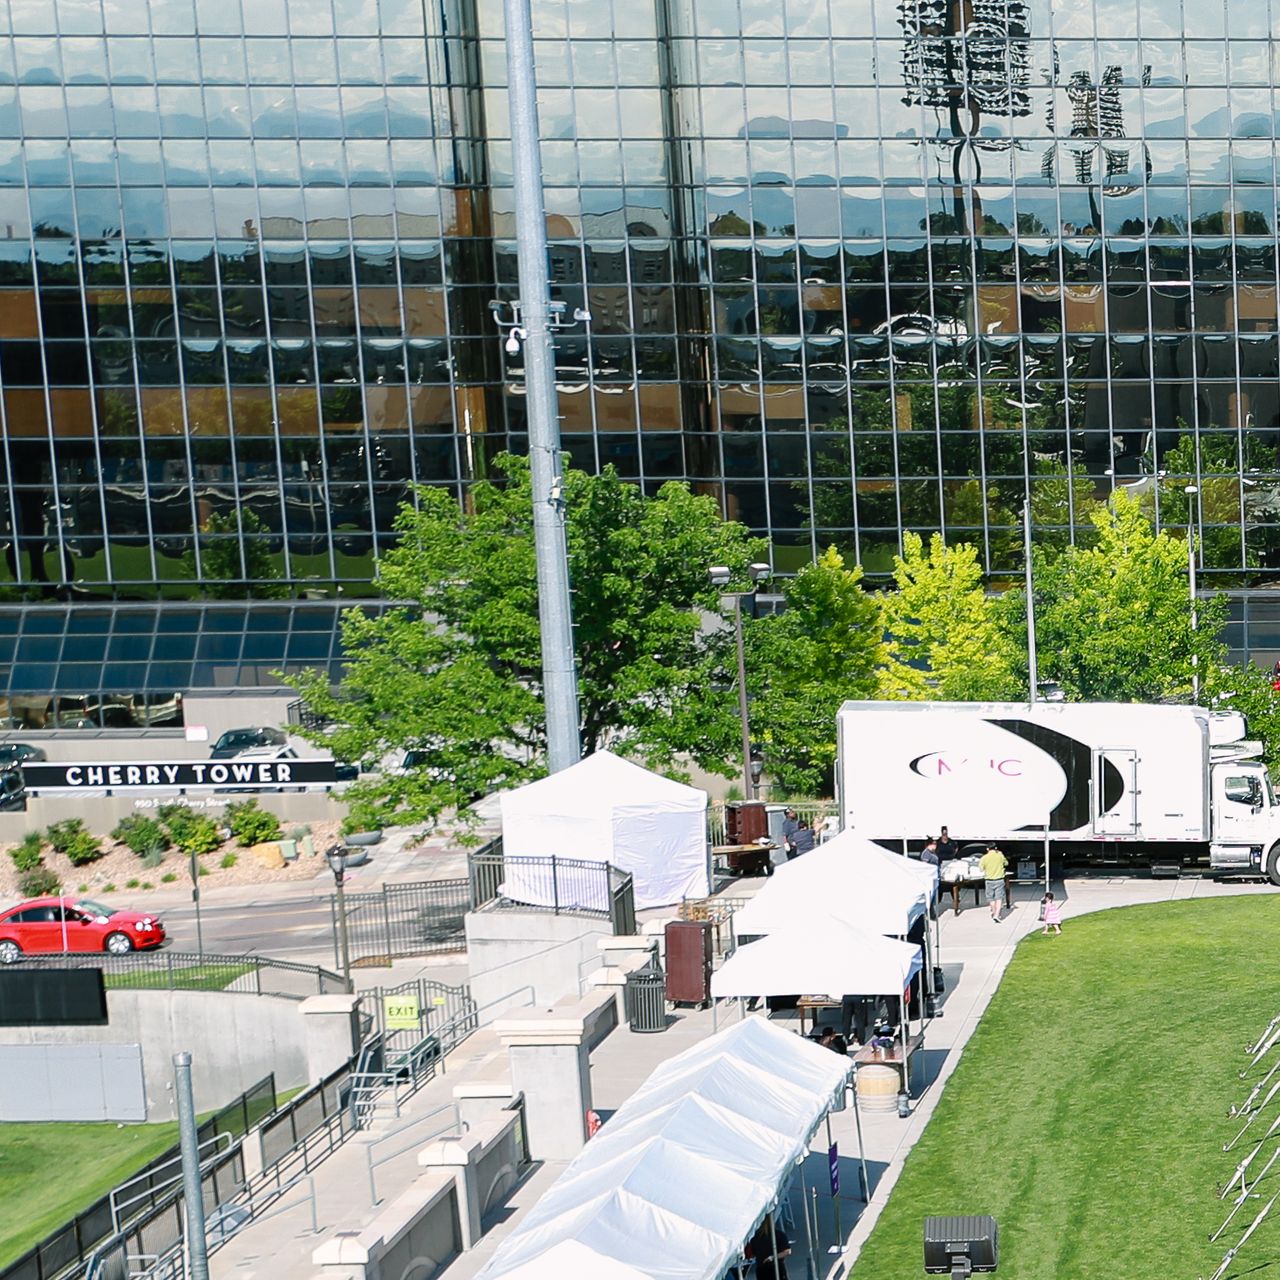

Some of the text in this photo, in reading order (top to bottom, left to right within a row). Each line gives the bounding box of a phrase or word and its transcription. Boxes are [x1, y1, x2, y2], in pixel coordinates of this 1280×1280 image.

[66, 763, 292, 786] CHERRY TOWER
[388, 1007, 414, 1016] EXIT
